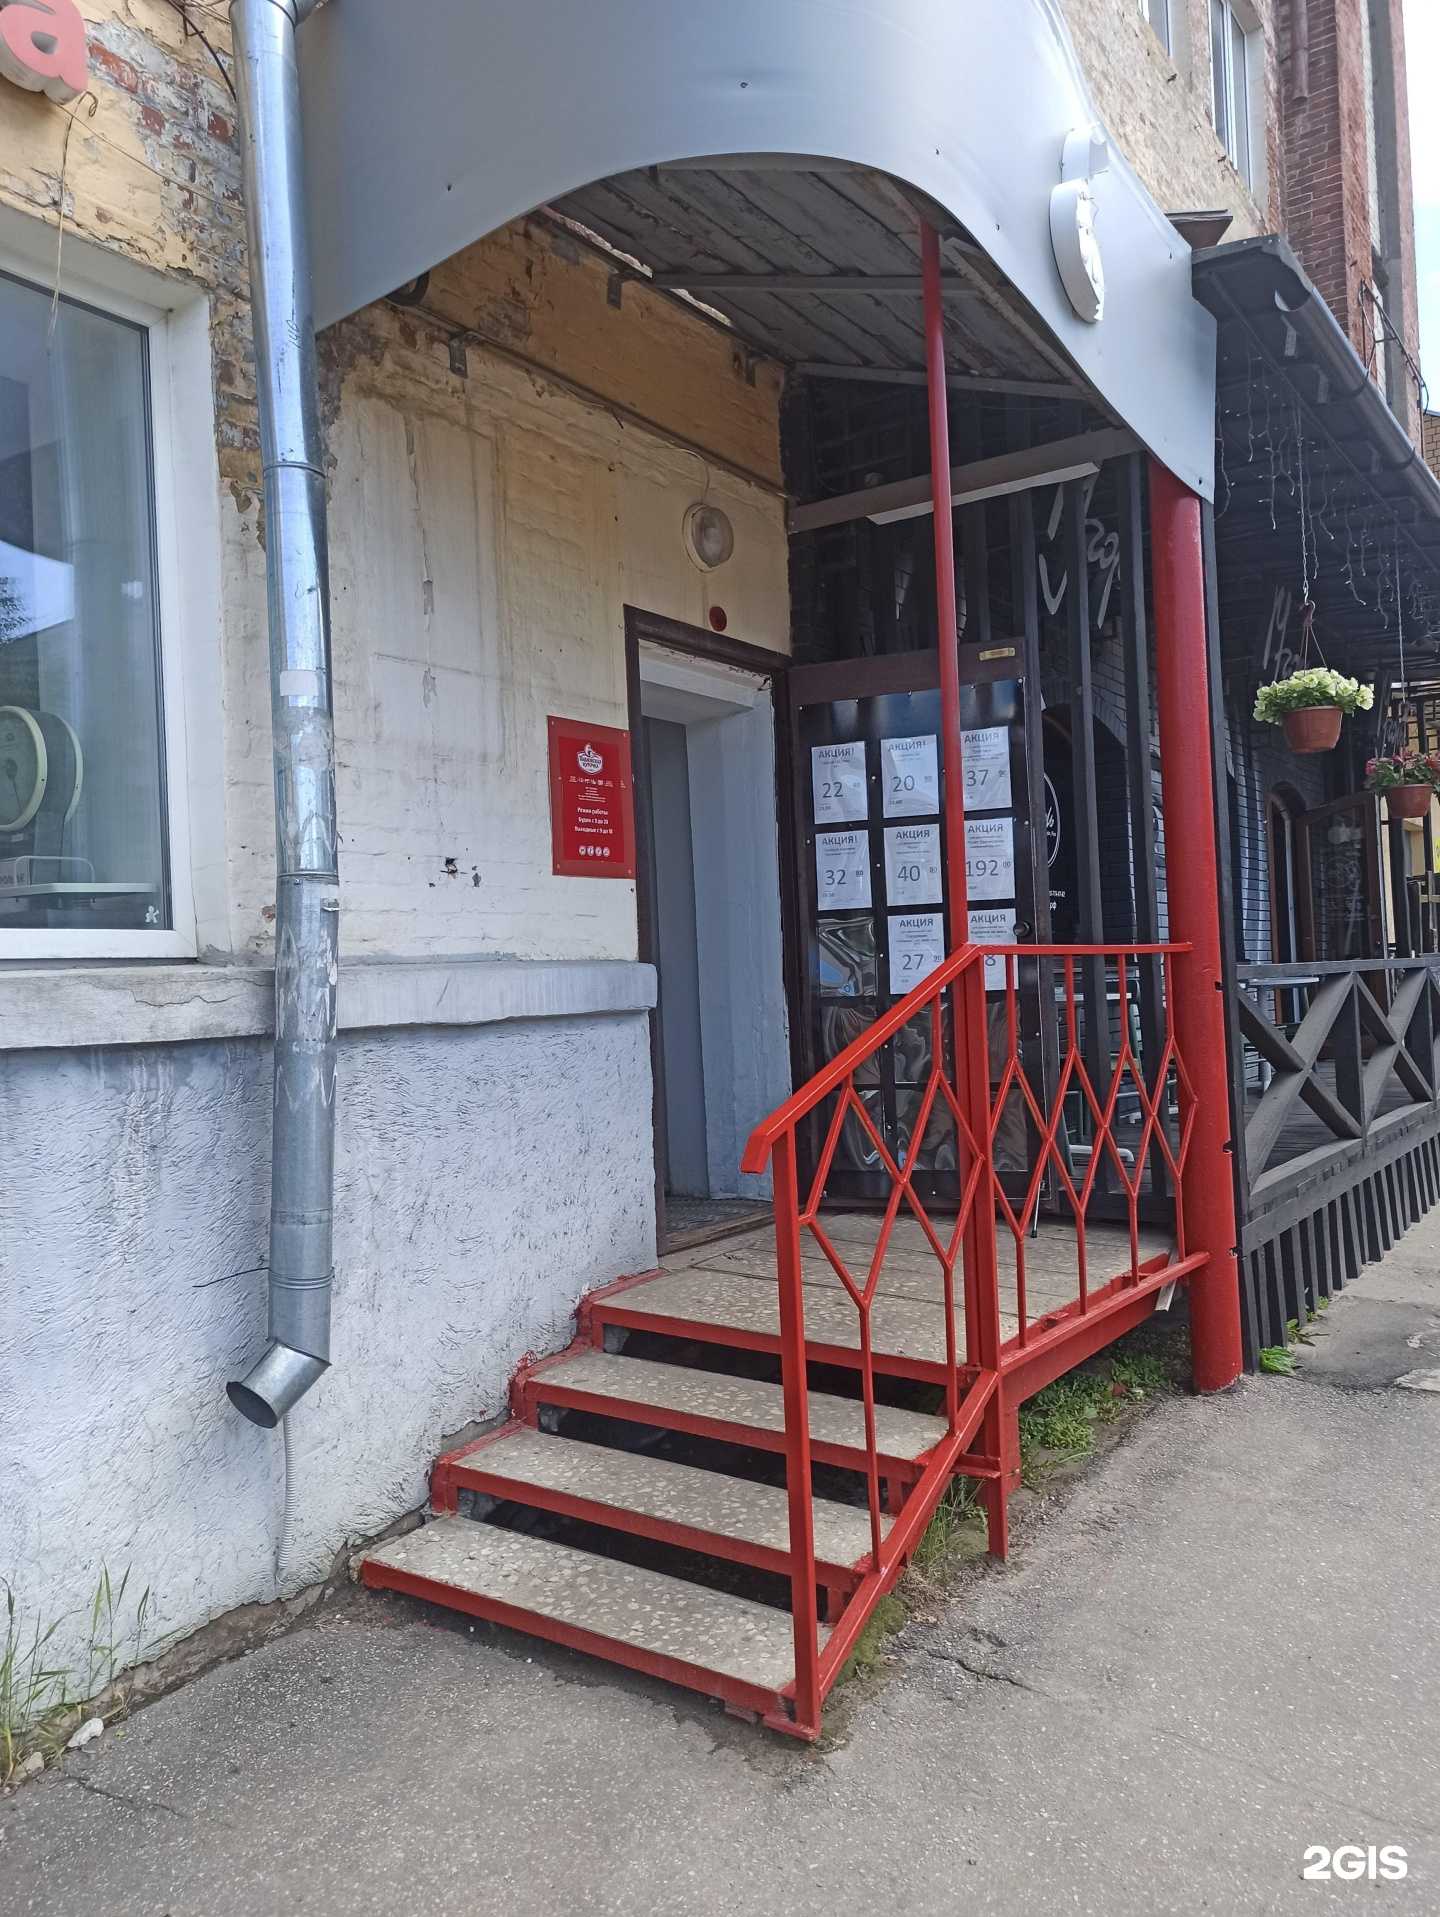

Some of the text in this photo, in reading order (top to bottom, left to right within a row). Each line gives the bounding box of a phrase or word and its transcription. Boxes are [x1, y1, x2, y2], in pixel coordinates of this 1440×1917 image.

[892, 775, 915, 792] 20
[966, 768, 989, 787] 37
[822, 782, 844, 798] 22
[896, 829, 930, 841] АКЦИЯ
[968, 823, 1004, 835] АКЦИЯ
[897, 865, 921, 882] 40
[965, 860, 999, 877] 192
[825, 869, 848, 886] 32
[900, 918, 934, 929] АКЦИЯ
[970, 913, 1006, 925] АКЦИЯ
[902, 954, 924, 970] 27
